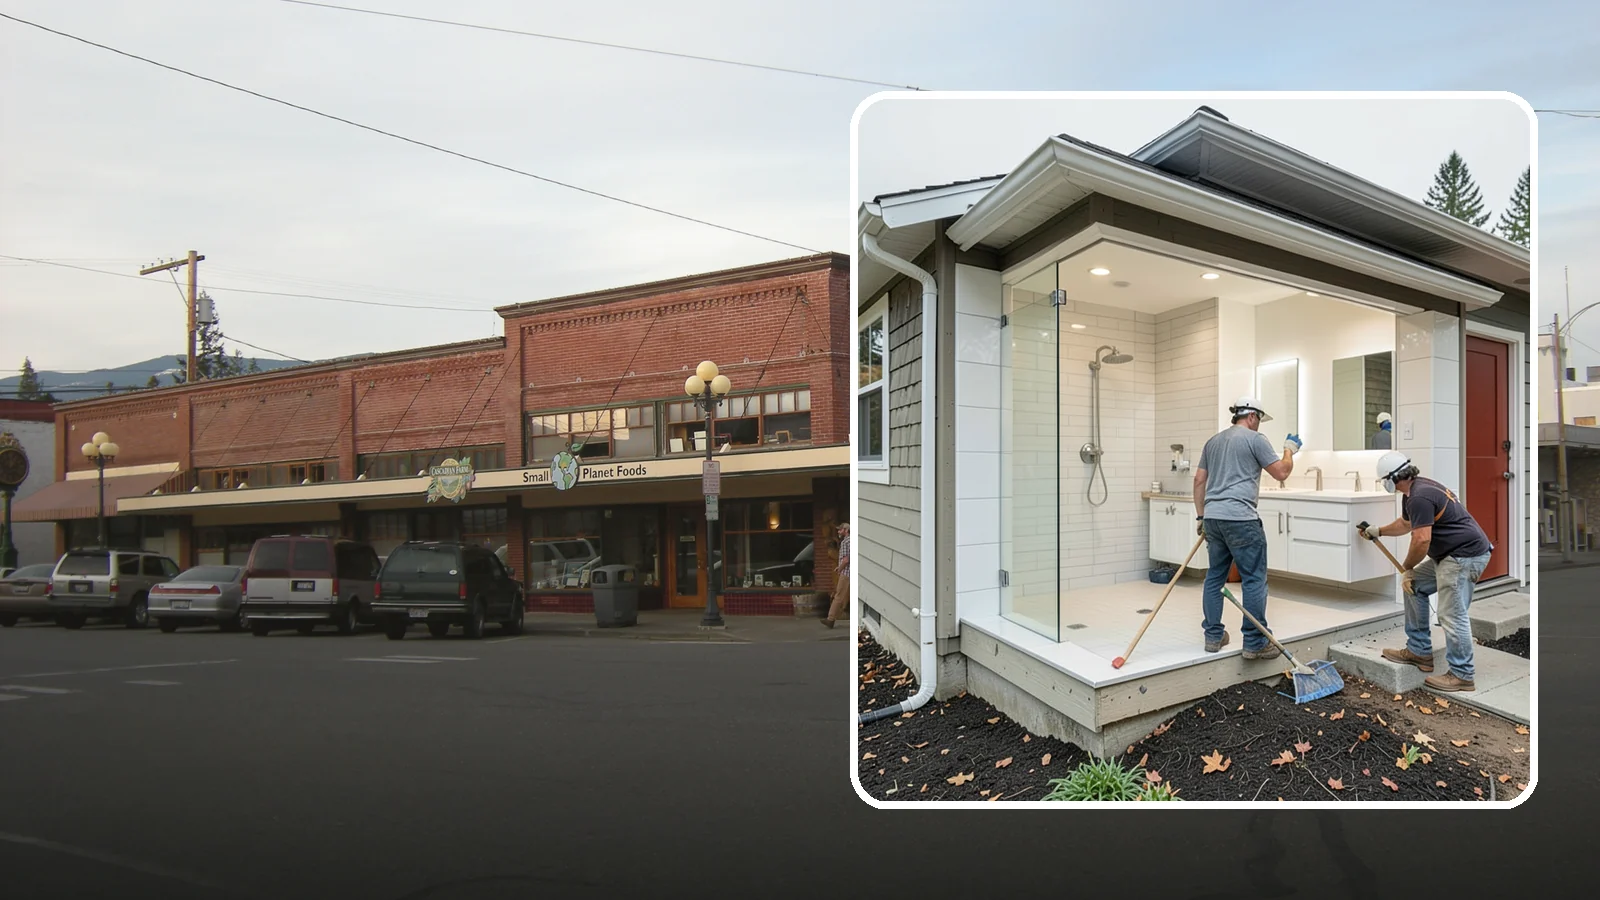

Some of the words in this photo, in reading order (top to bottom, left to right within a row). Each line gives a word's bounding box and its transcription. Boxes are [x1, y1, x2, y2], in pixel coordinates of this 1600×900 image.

[523, 471, 549, 483] Small
[582, 467, 614, 479] Planet
[617, 464, 647, 477] Foods
